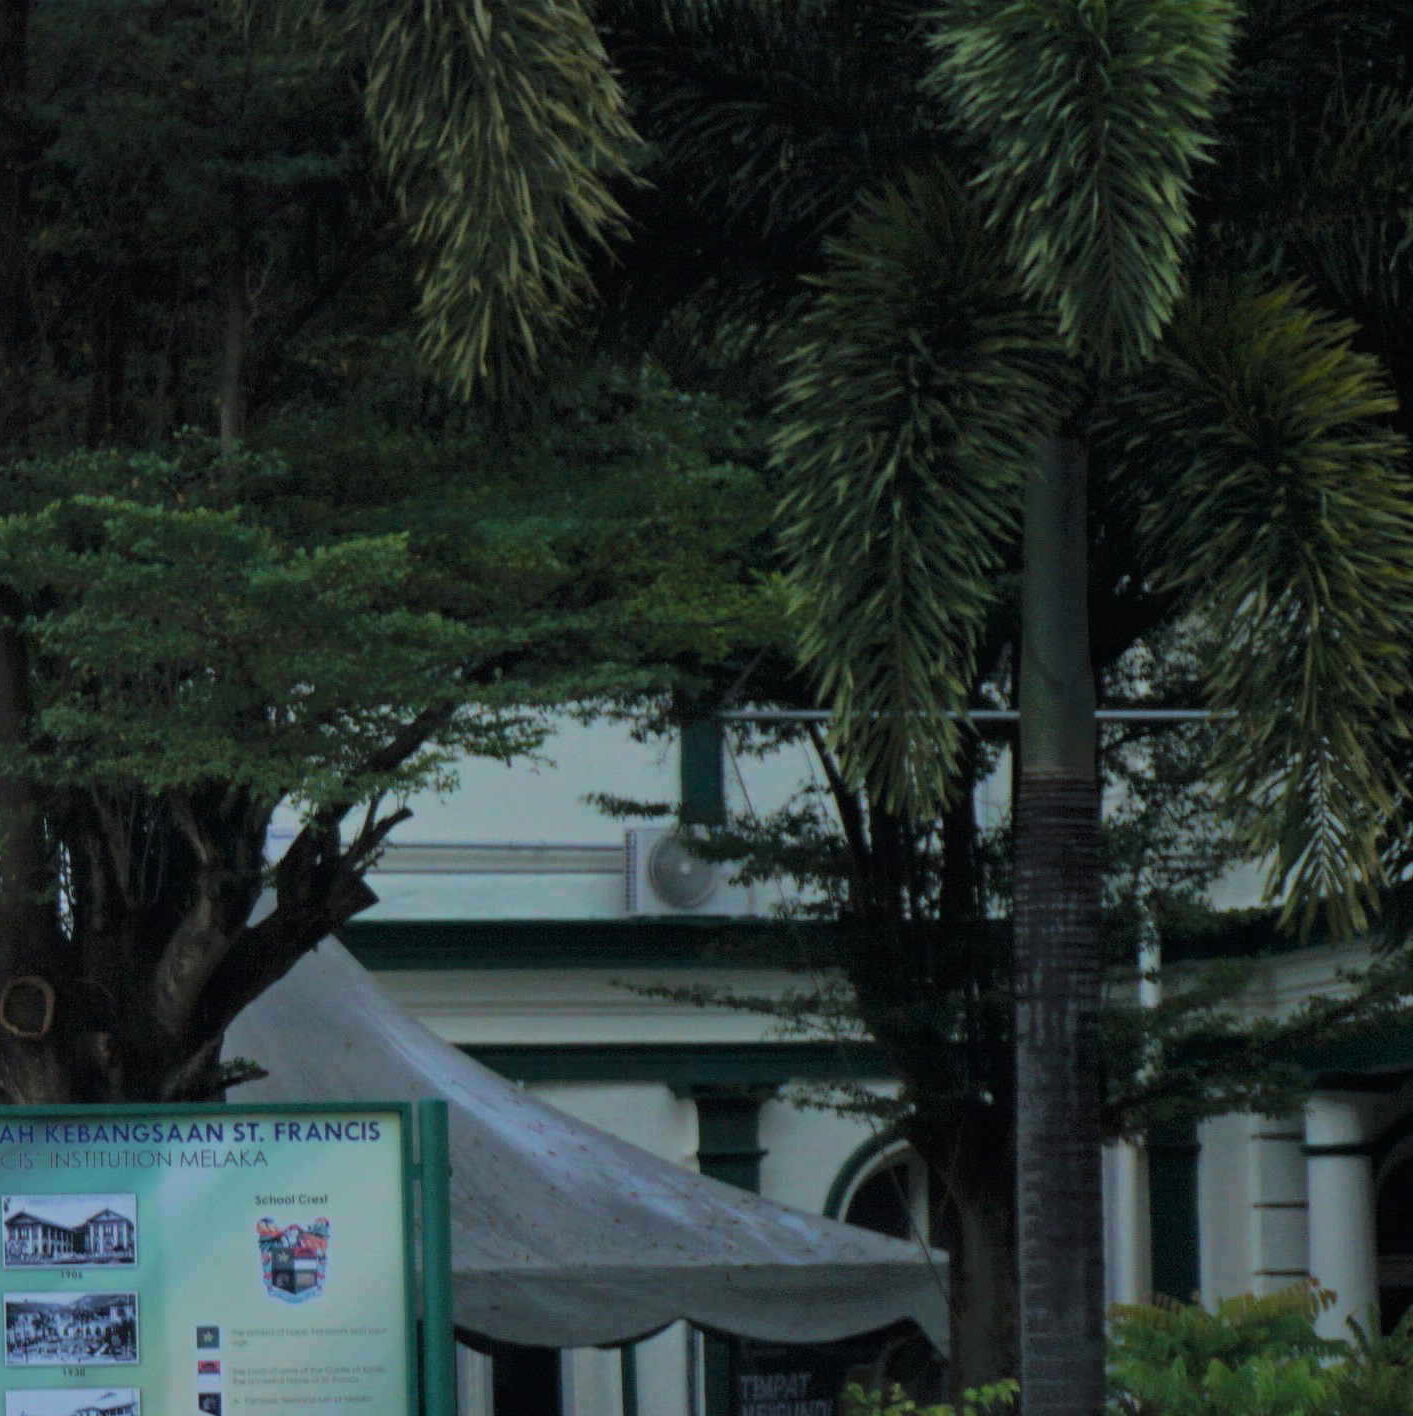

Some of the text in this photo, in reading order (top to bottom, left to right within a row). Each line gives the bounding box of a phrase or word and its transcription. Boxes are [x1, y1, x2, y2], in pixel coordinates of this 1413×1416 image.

[46, 1122, 223, 1145] KEBANGSAAN
[233, 1123, 264, 1142] ST.
[275, 1121, 380, 1141] FRANCIS
[49, 1149, 171, 1168] INSTITUTION
[180, 1149, 268, 1167] MELAKA
[255, 1194, 329, 1206] School Crest
[740, 1371, 812, 1400] TEMPAT
